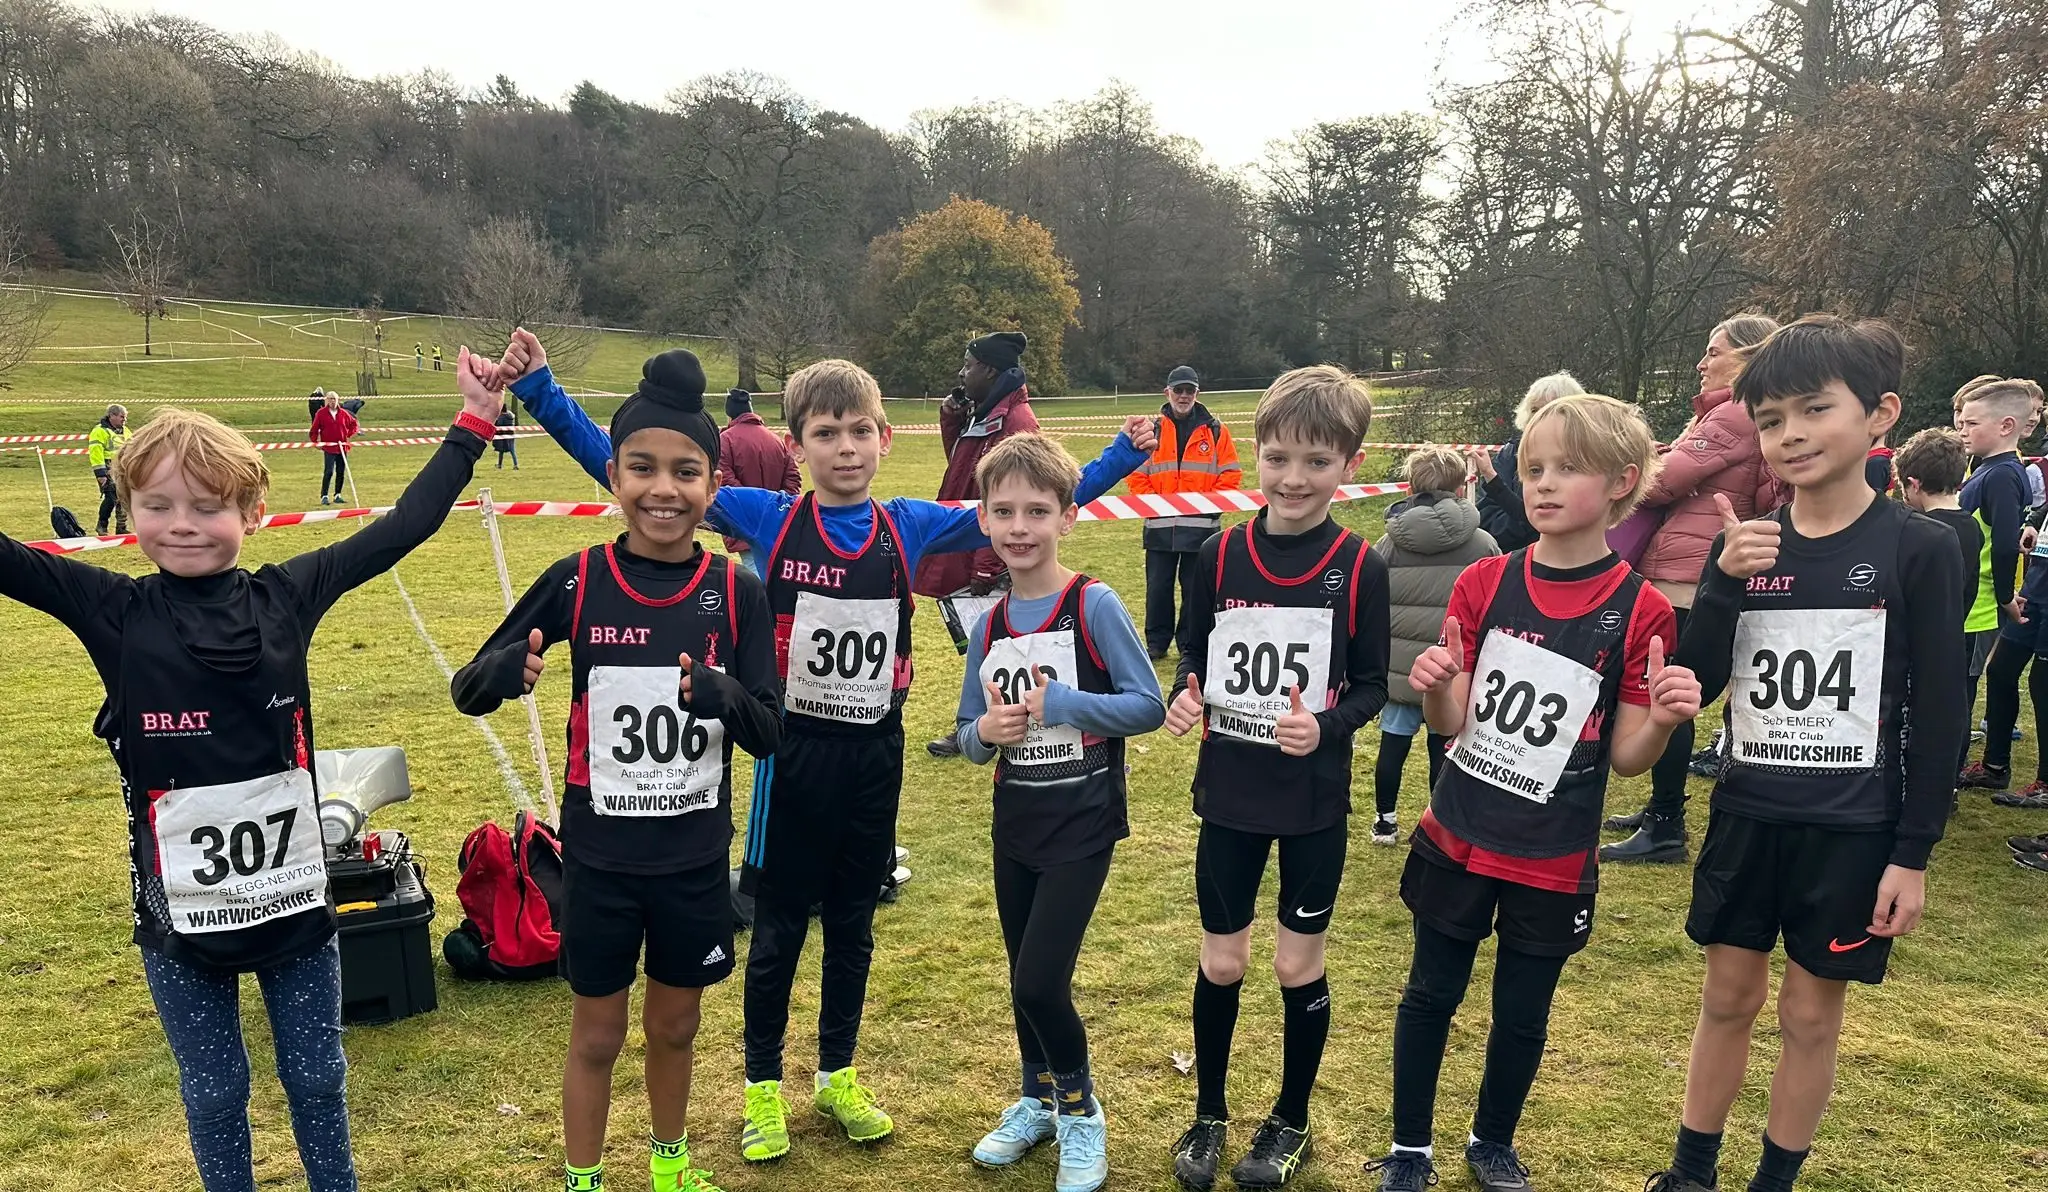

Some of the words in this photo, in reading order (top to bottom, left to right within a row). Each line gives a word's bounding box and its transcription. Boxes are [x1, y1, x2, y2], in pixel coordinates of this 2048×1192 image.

[780, 560, 847, 588] BRAT
[590, 627, 650, 645] BRAT
[807, 628, 887, 680] 309
[1224, 641, 1310, 697] 305
[1749, 648, 1856, 712] 304
[797, 676, 831, 690] Thomas
[834, 682, 889, 693] WOODWARD
[795, 697, 885, 719] WARWICKSHIRE
[823, 692, 845, 702] BRAT
[848, 695, 866, 703] Club
[1225, 699, 1257, 709] Charlie
[1259, 701, 1303, 710] KEEN
[1474, 669, 1568, 748] 303
[141, 711, 210, 730] BRAT
[1219, 713, 1277, 739] WARWICK
[1762, 715, 1783, 725] Seb
[1787, 716, 1835, 727] EMERY
[612, 704, 709, 764] 306
[1474, 728, 1492, 744] Alex
[1494, 737, 1528, 757] BONE
[1768, 730, 1796, 740] BRAT
[1799, 731, 1824, 741] Club
[1471, 741, 1494, 758] BRAT
[1495, 752, 1515, 766] Club
[1742, 741, 1863, 762] WARWICKSHIRE
[621, 768, 663, 779] Anaadh
[666, 767, 699, 779] SINGH
[1453, 745, 1545, 797] WARWICKSHIRE
[636, 783, 663, 791] BRAT
[666, 782, 686, 791] Club
[603, 789, 709, 811] WARWICKSHIRE
[190, 807, 298, 886] 307
[219, 863, 322, 897] SLEGG-NEWTON
[187, 888, 317, 928] WARWICKSHIRE
[226, 896, 256, 905] BRAT
[259, 890, 282, 902] Club
